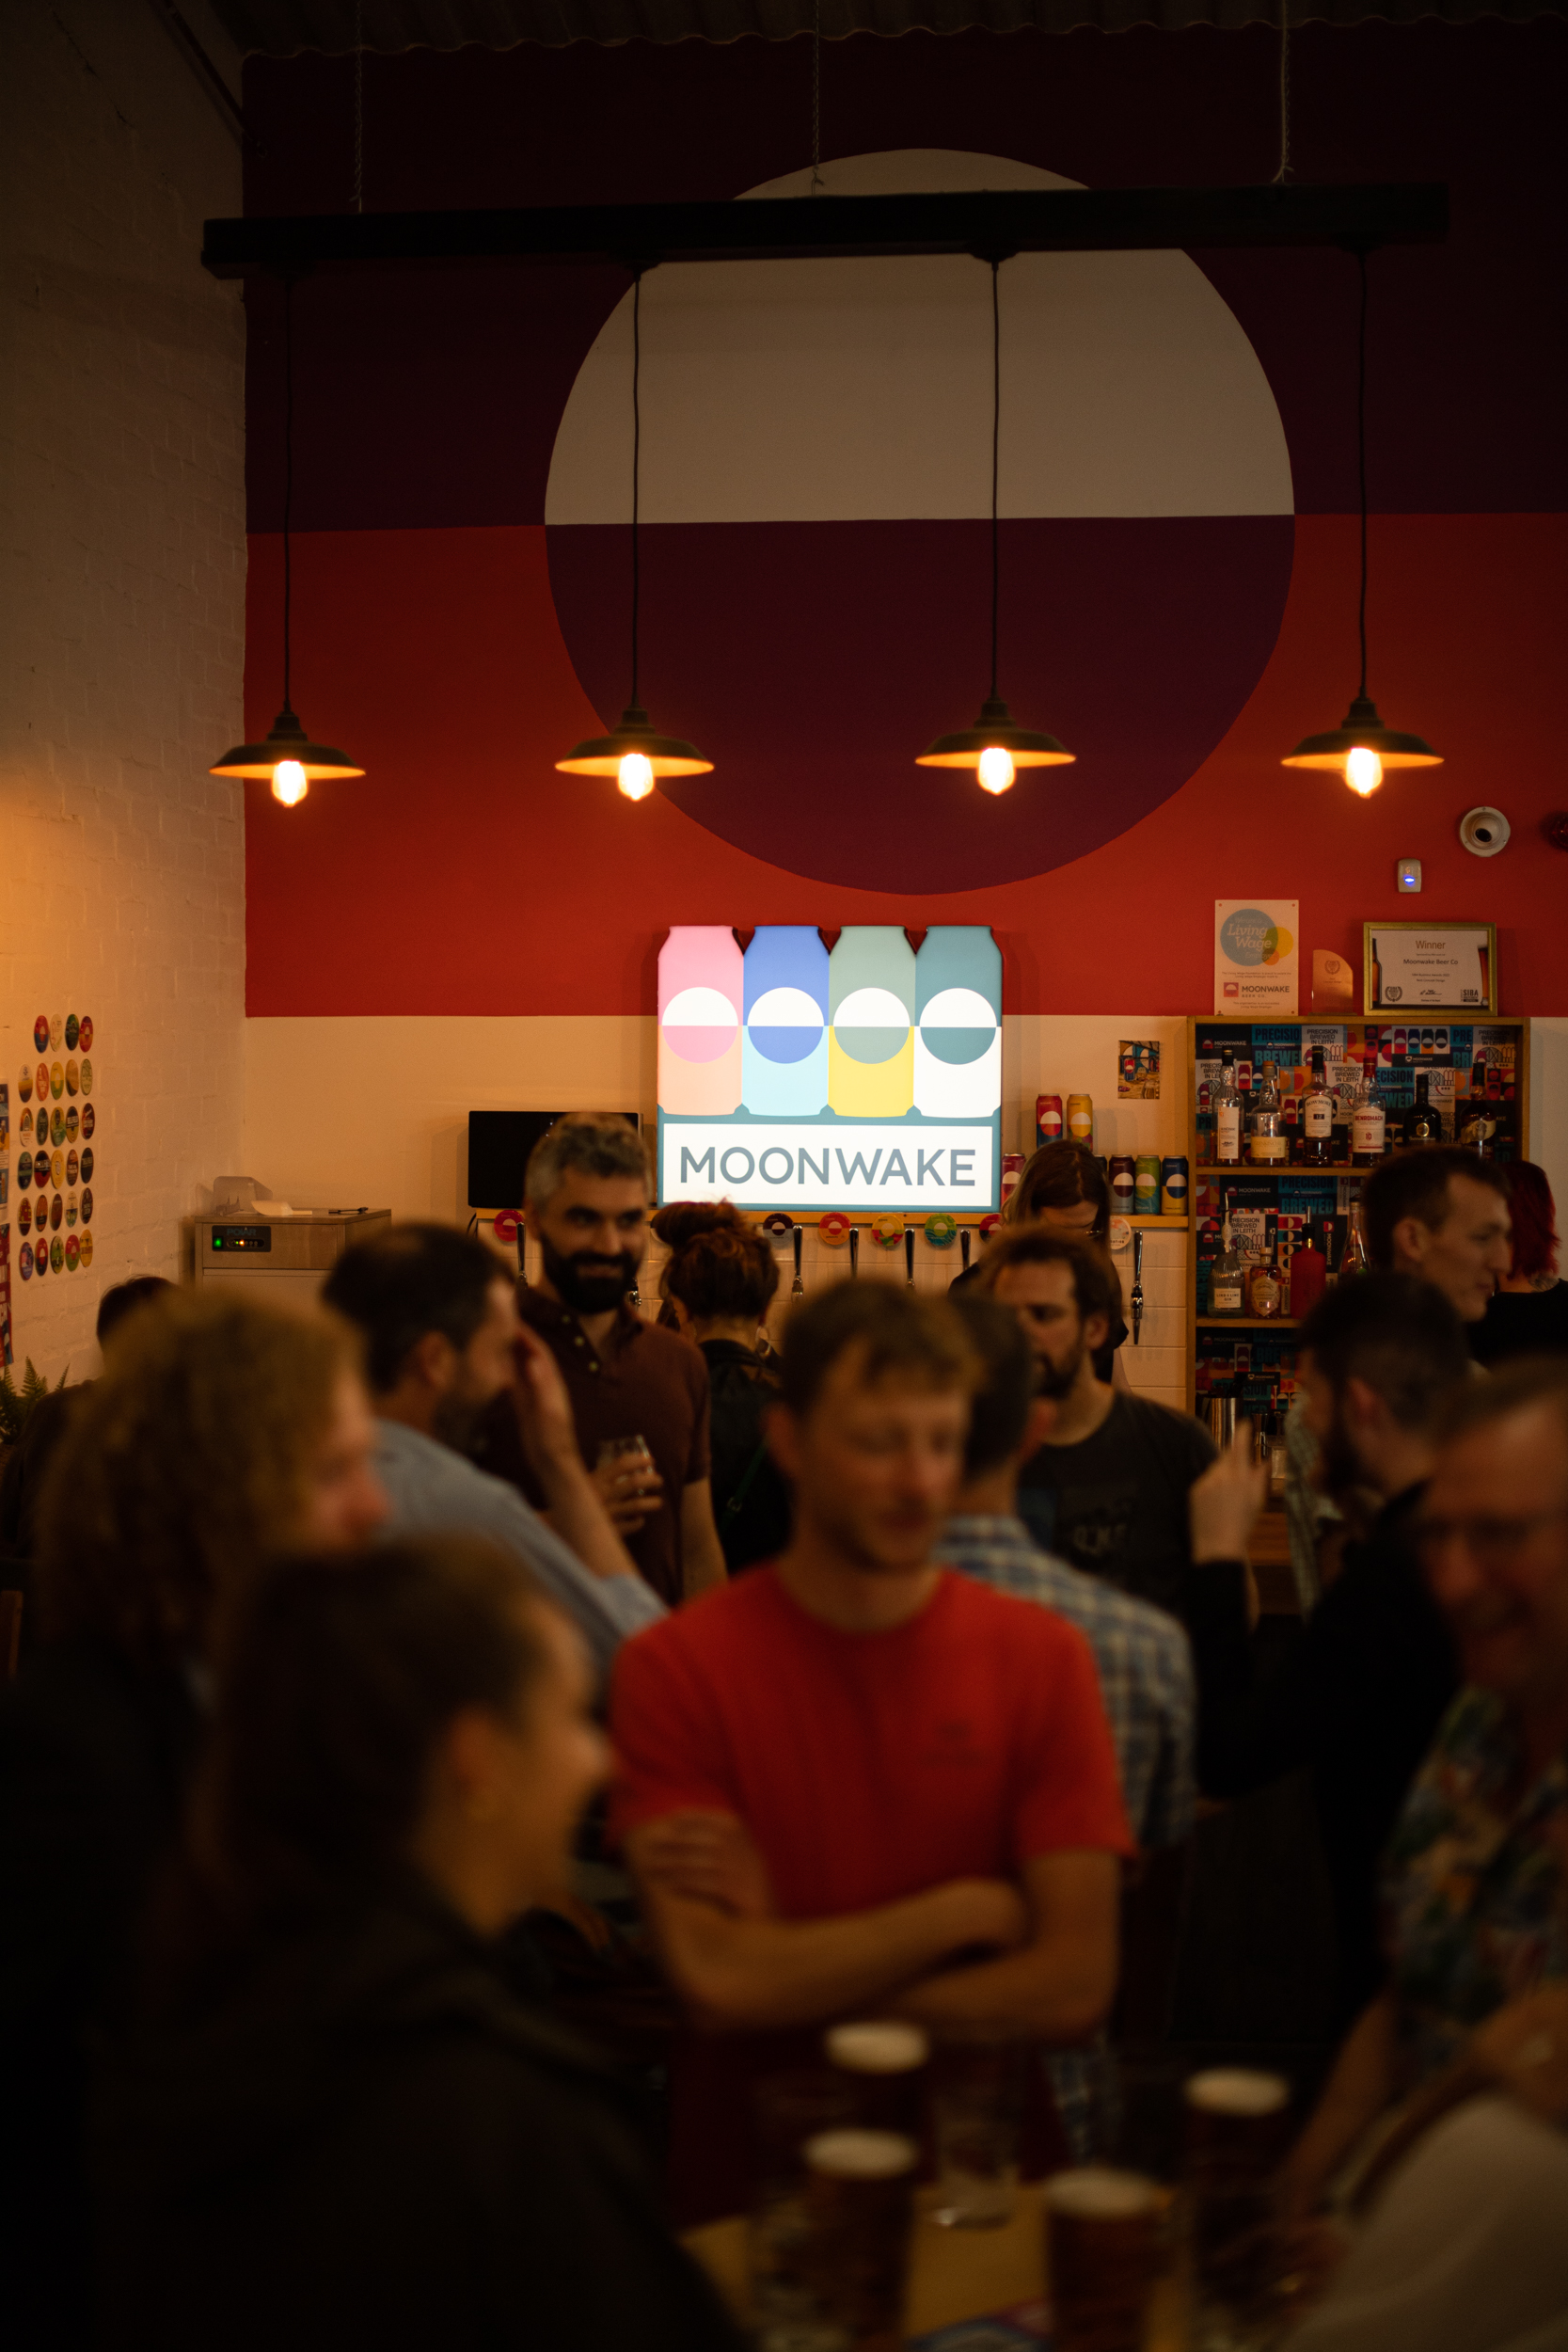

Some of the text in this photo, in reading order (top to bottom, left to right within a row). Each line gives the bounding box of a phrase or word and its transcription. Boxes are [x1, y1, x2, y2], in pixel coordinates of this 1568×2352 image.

[1227, 923, 1268, 939] Living
[1234, 936, 1272, 952] Wage
[1416, 940, 1446, 950] Winner
[680, 1146, 976, 1187] MOONWAKE
[1281, 1175, 1334, 1188] PRECISION
[1281, 1198, 1334, 1214] BREWED
[227, 1227, 257, 1236] POLAR
